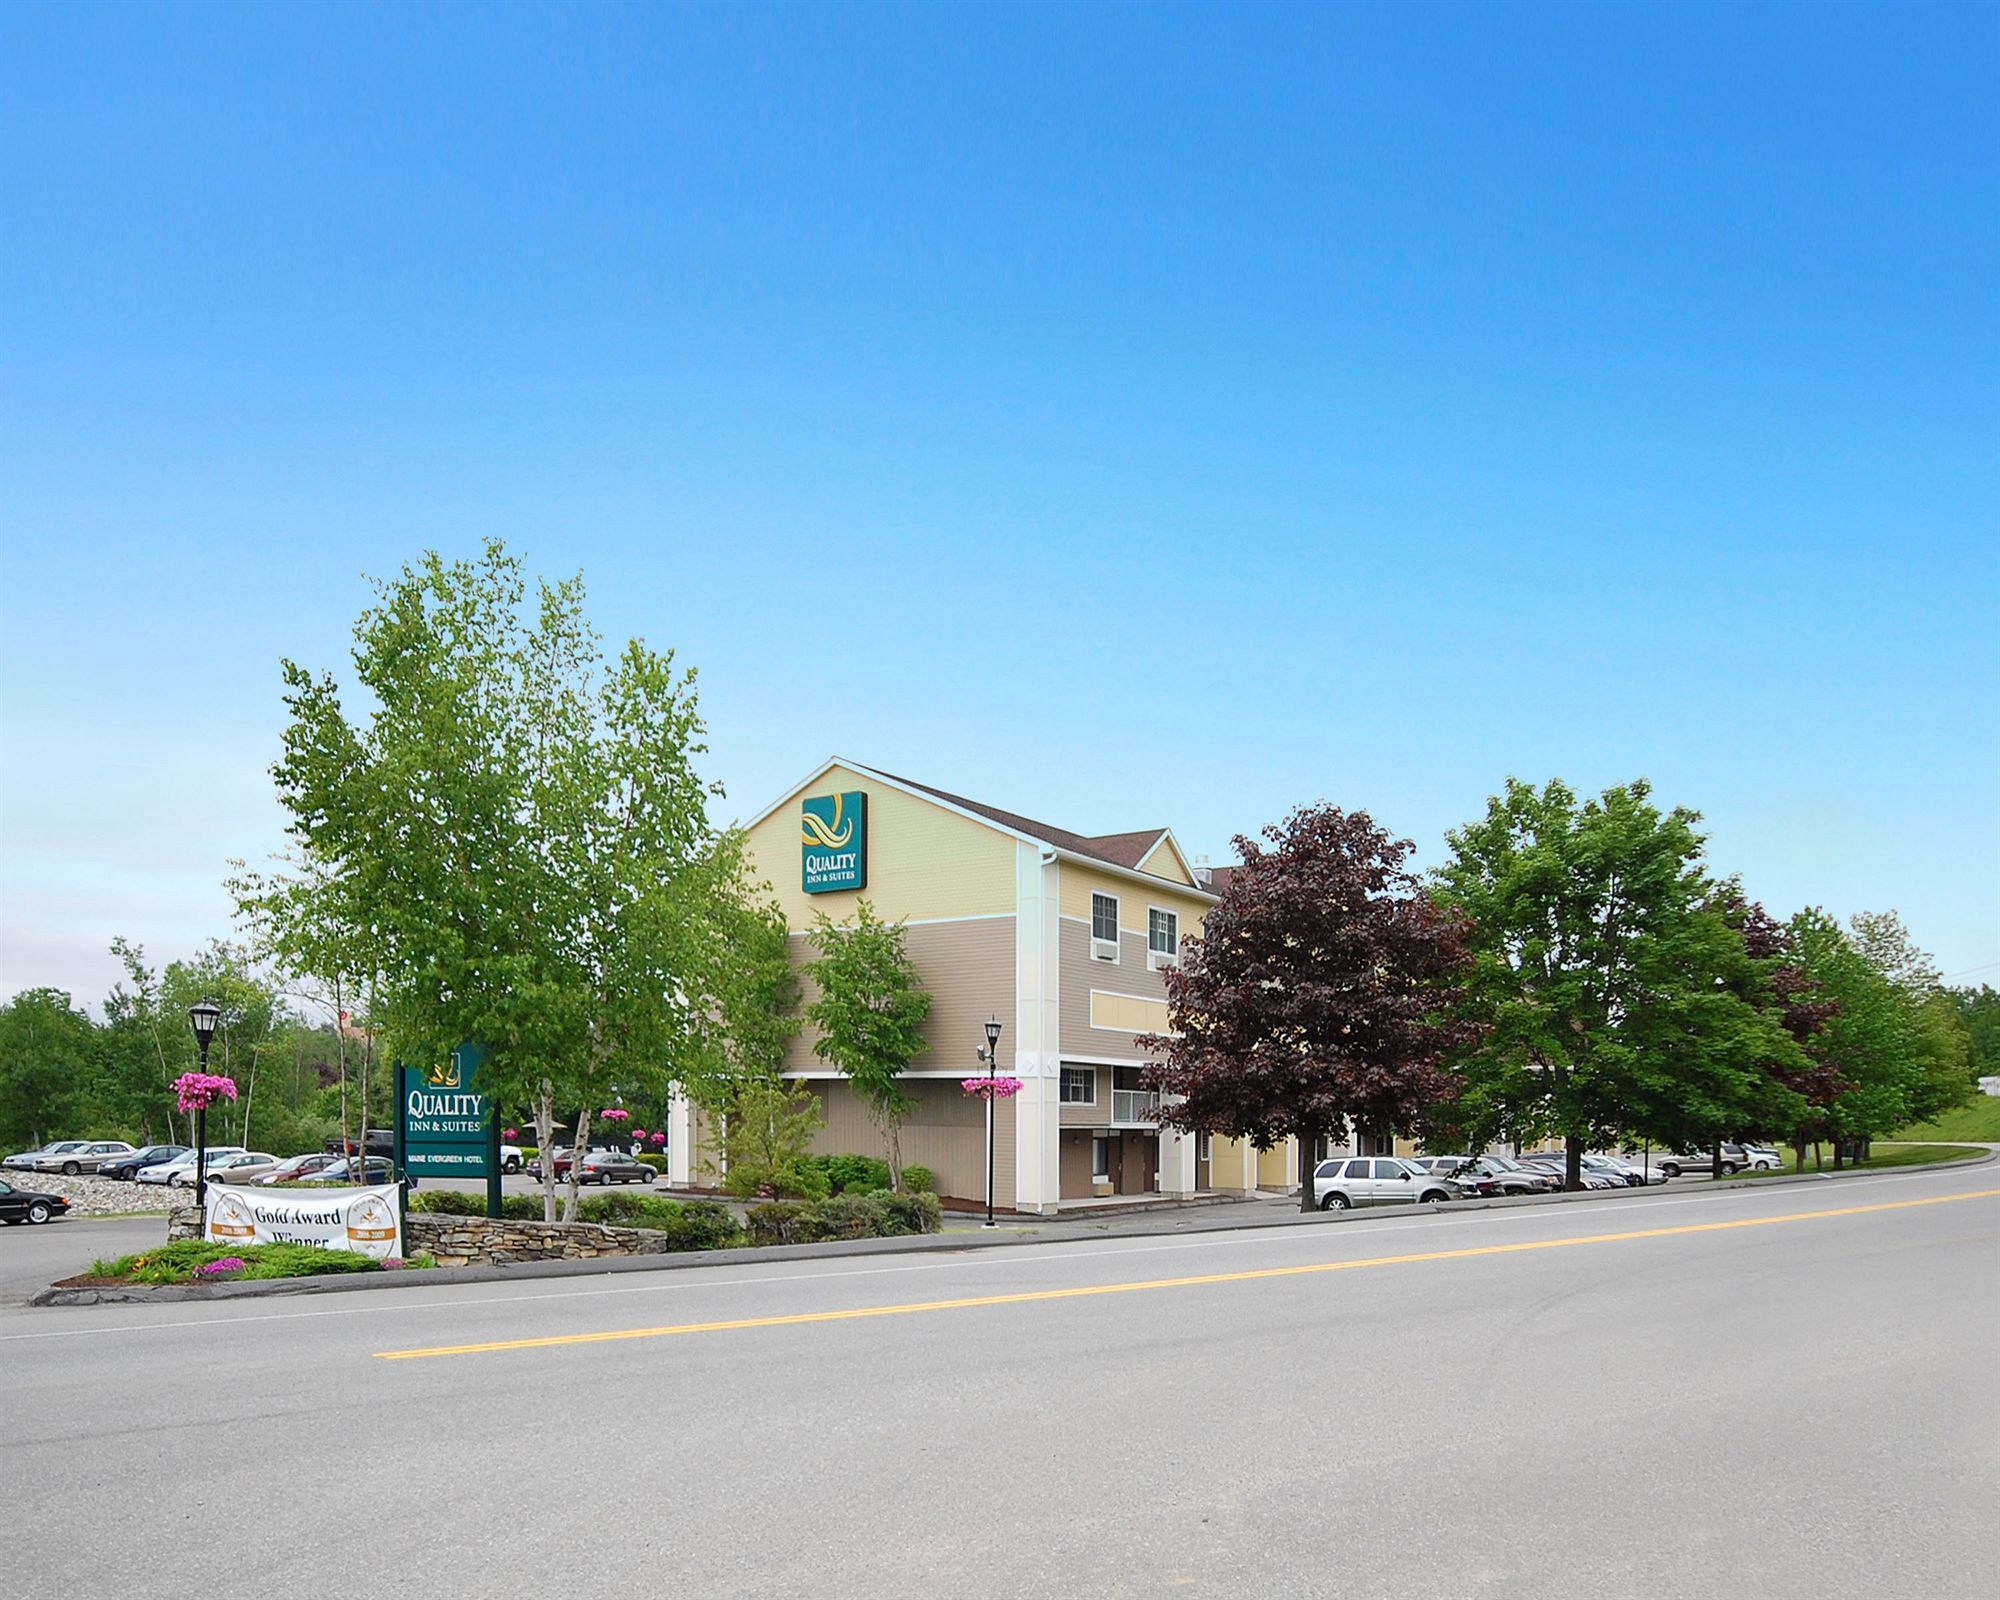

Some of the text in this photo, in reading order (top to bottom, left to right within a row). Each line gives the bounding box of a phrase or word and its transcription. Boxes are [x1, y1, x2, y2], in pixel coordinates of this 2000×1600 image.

[806, 853, 856, 875] QUALITY
[807, 870, 855, 884] INN & SUITES
[408, 1090, 482, 1119] QUALITY
[409, 1121, 481, 1132] INN & SUITES
[463, 1155, 484, 1164] HOTEL
[254, 1205, 342, 1225] Gold Award
